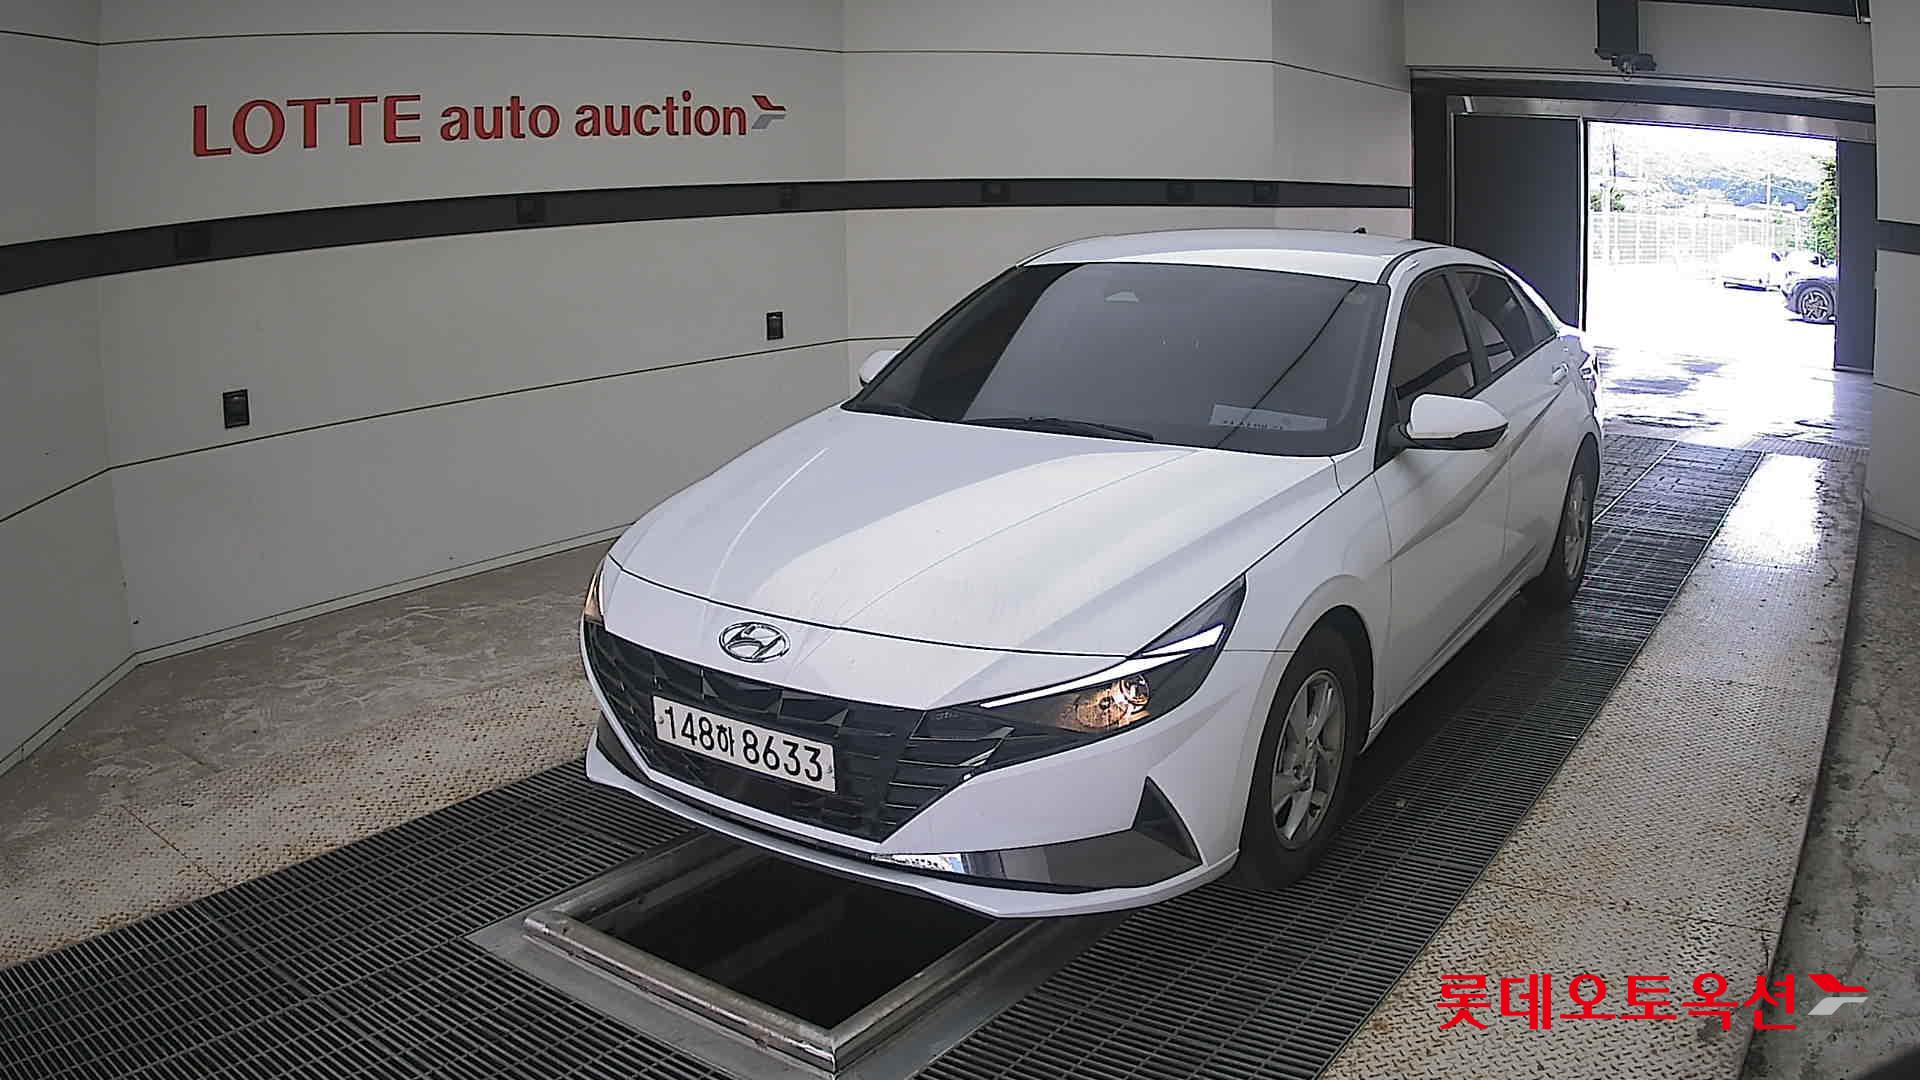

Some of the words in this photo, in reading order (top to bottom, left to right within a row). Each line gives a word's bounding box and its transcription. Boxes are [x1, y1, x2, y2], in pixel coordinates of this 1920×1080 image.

[192, 94, 421, 157] LOTTE
[440, 96, 560, 141] auto
[575, 90, 747, 137] auction
